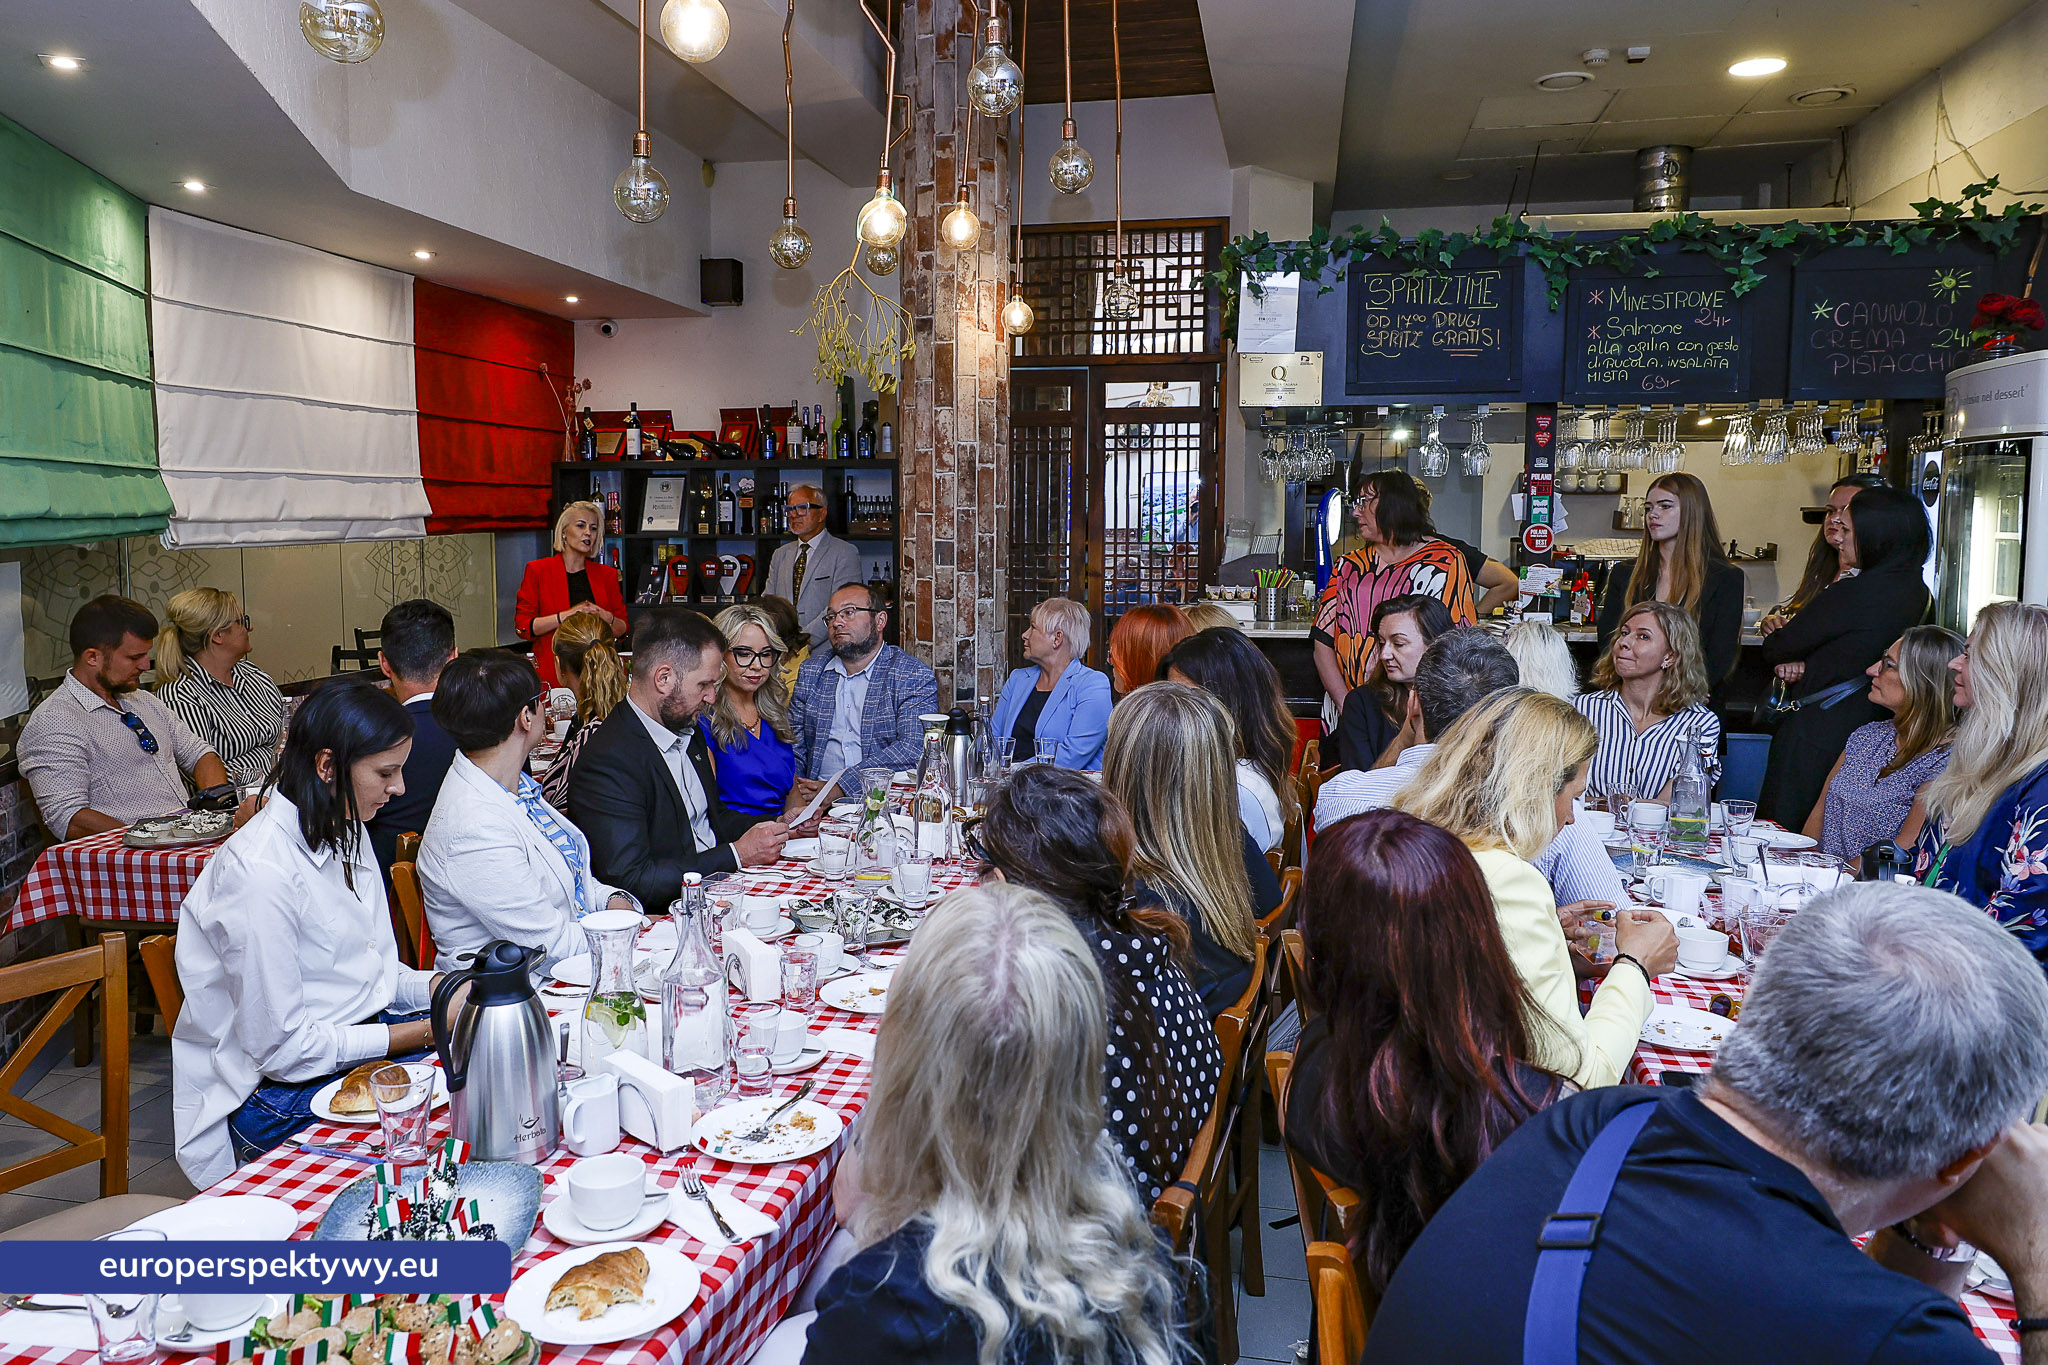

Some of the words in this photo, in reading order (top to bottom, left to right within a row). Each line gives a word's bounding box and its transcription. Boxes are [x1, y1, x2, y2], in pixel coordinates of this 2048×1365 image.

[1608, 285, 1727, 312] MINESTRONE
[1366, 314, 1391, 329] OD
[1432, 311, 1482, 329] DRUGI
[1366, 330, 1424, 349] SPRITZ
[1811, 328, 1905, 350] CREMA
[1587, 370, 1628, 383] MISTA
[1995, 385, 2025, 401] dessert
[1531, 473, 1552, 481] POLAND
